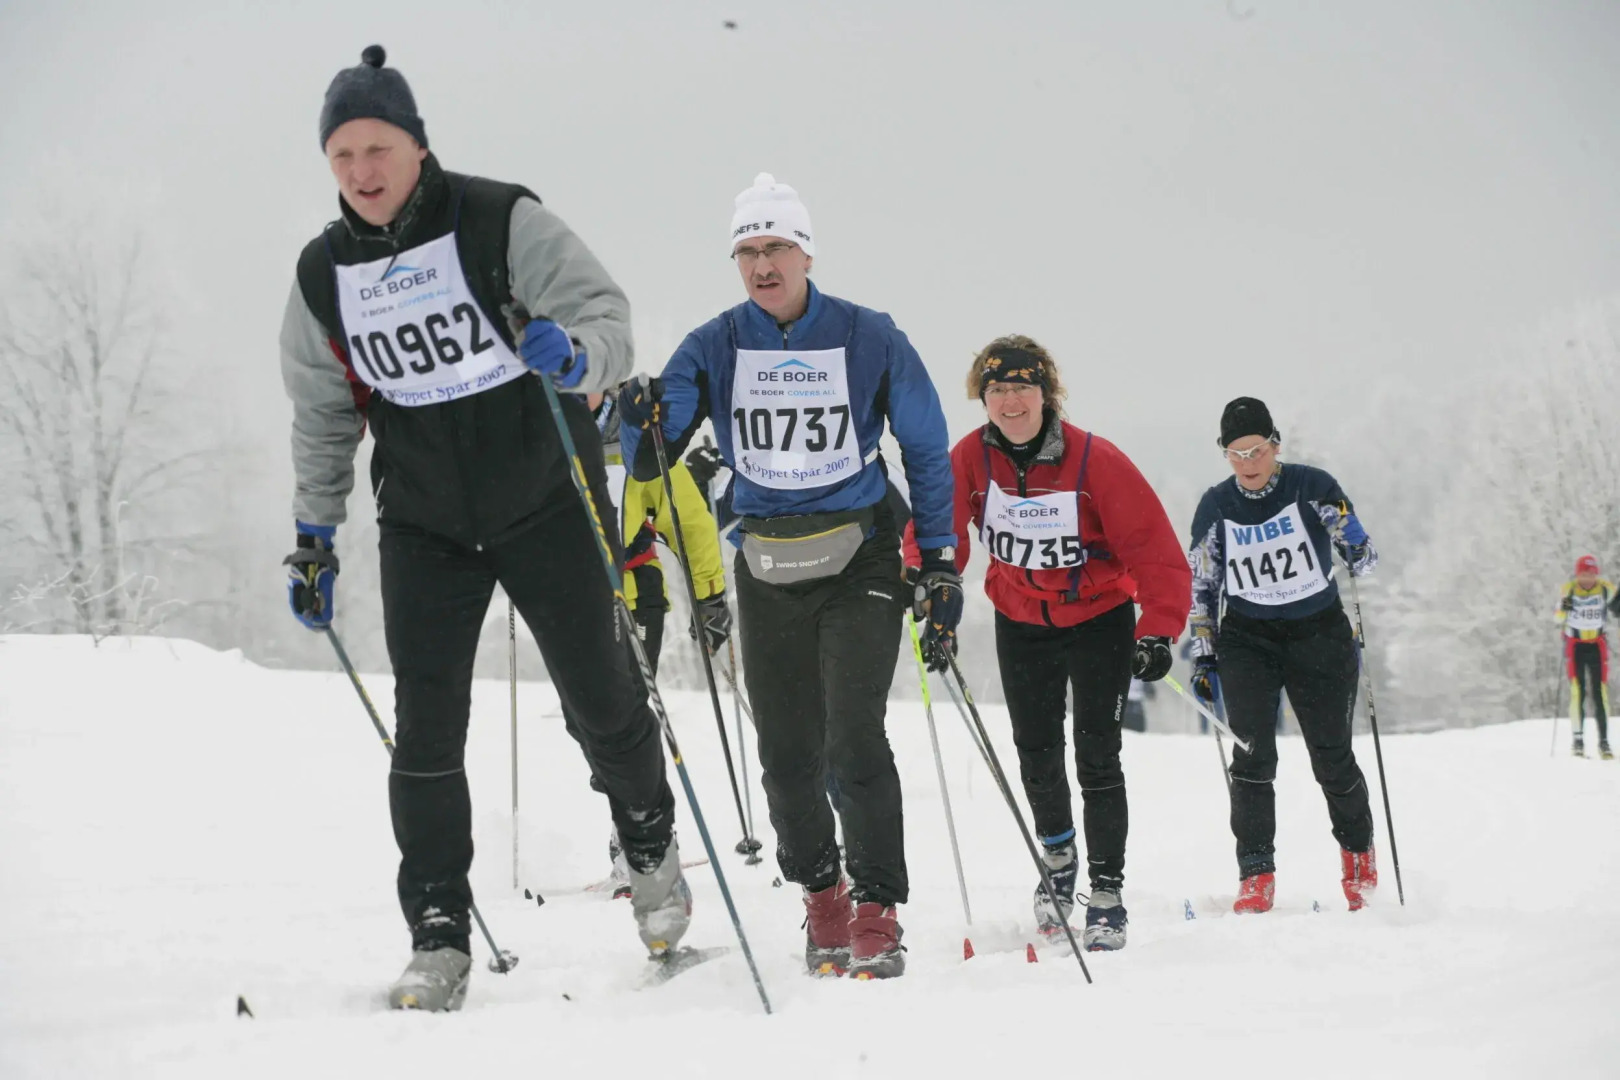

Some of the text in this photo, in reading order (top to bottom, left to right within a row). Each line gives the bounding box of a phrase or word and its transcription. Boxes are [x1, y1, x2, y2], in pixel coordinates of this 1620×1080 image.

[360, 268, 438, 301] DE BOER
[351, 302, 495, 381] 10962
[476, 364, 507, 388] 2007
[758, 371, 828, 382] DE BOER
[733, 404, 850, 452] 10737
[752, 456, 850, 481] Öppet Spår 2007
[1019, 507, 1059, 518] BOER
[1232, 515, 1294, 545] WIBE
[986, 525, 1082, 569] 10735
[798, 560, 819, 568] SNOW
[1228, 541, 1314, 590] 11421
[1300, 578, 1319, 592] 2007
[1114, 693, 1123, 722] CRAFT
